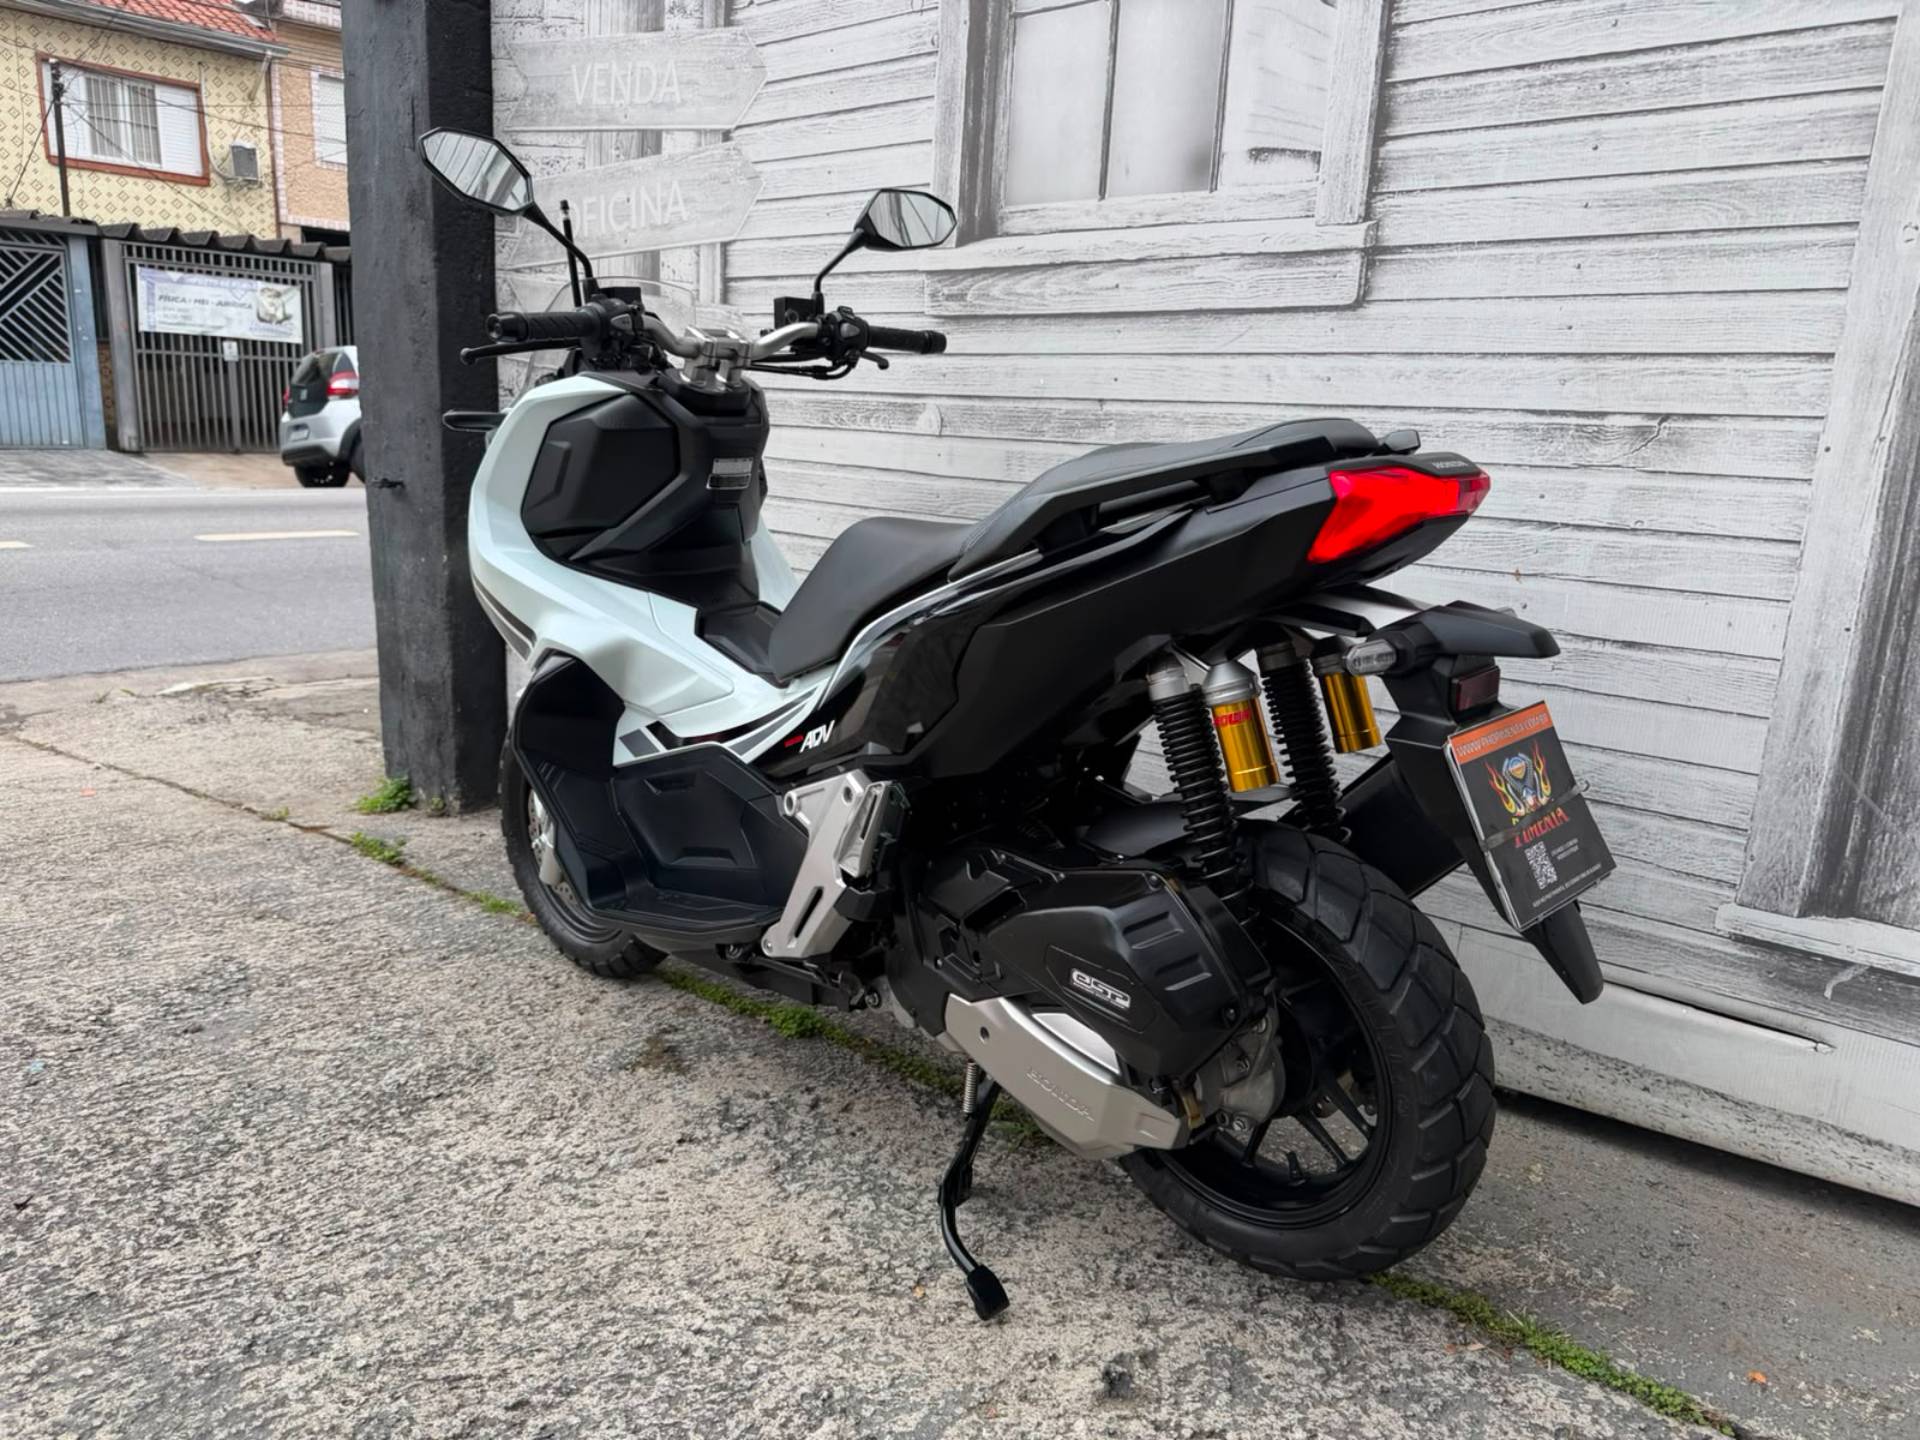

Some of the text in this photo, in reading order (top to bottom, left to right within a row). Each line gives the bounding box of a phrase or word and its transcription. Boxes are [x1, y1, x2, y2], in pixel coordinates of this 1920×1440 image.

[571, 60, 681, 105] VENDA
[560, 180, 689, 238] OFICINA
[799, 720, 835, 753] ADV
